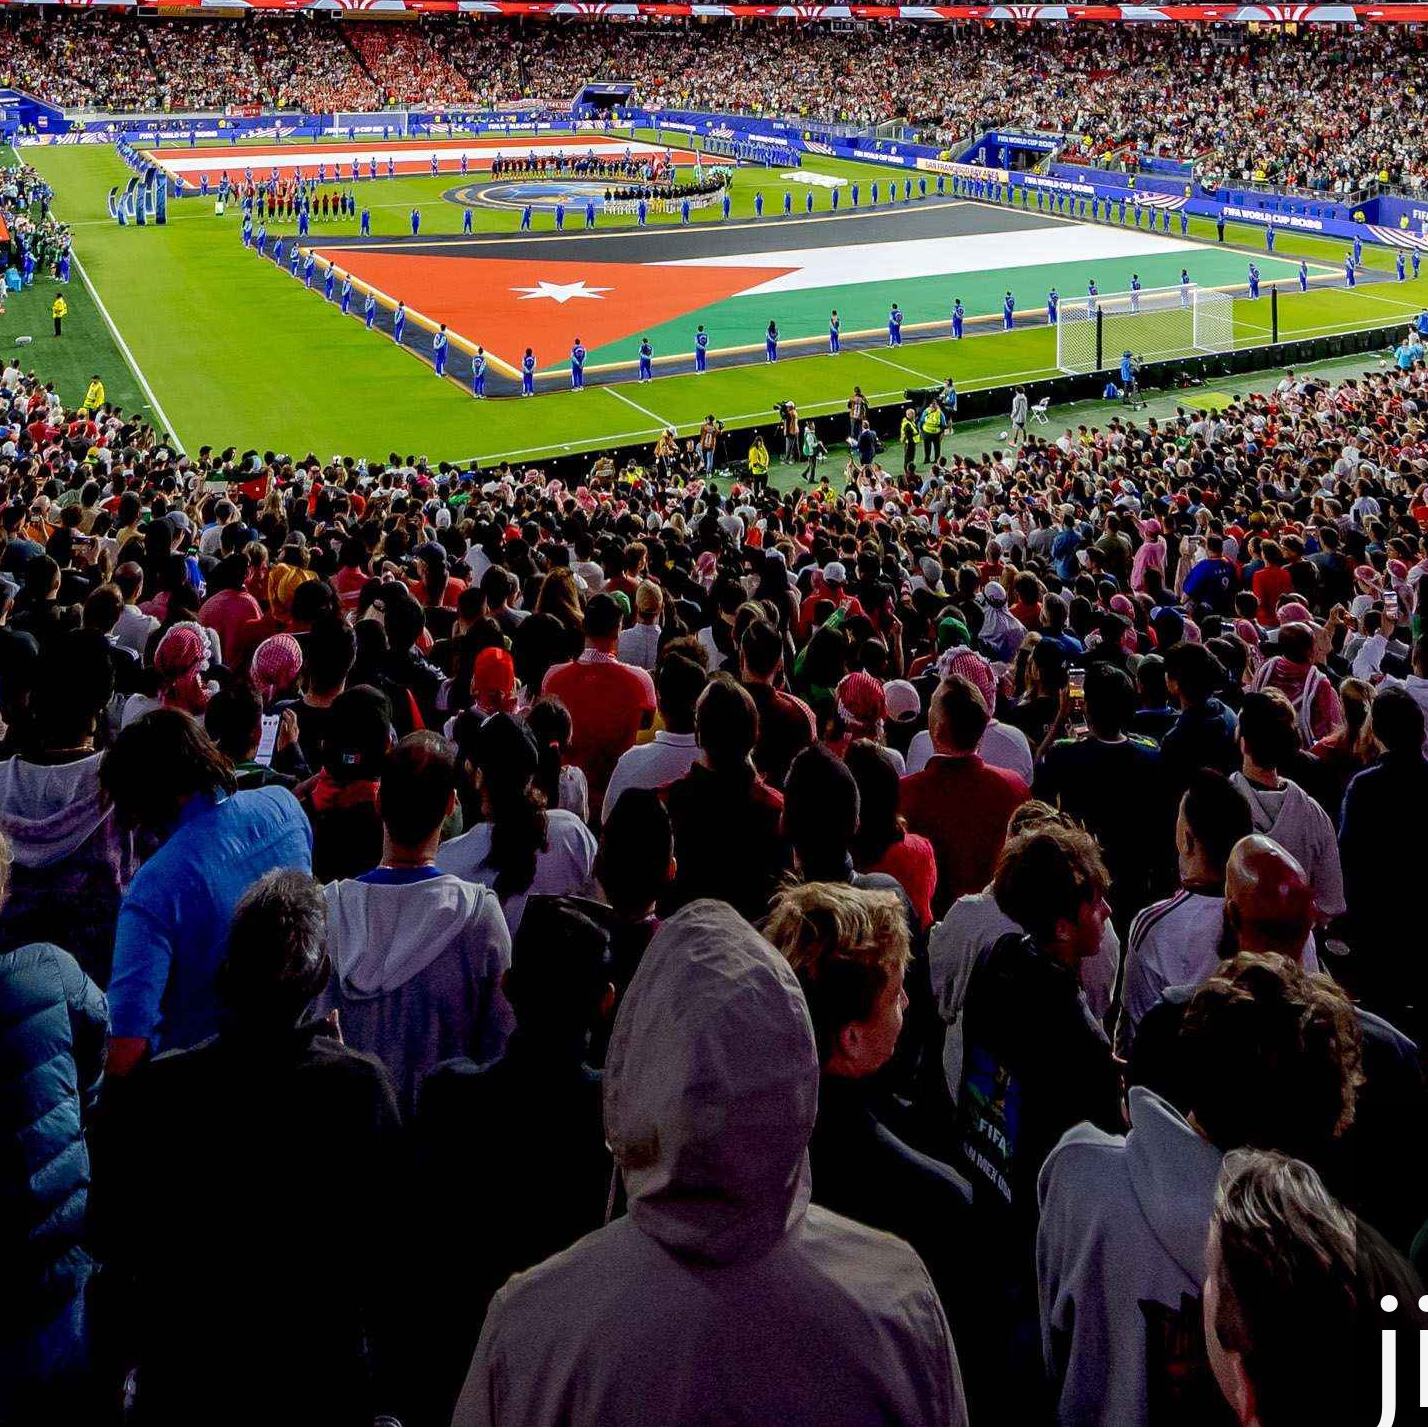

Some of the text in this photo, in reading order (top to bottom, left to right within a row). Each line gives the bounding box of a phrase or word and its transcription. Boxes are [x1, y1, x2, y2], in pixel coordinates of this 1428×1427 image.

[1223, 206, 1241, 217] FIFA
[1241, 208, 1272, 222] WORLD
[1272, 214, 1290, 225] CUP
[976, 1117, 1006, 1159] FIFA
